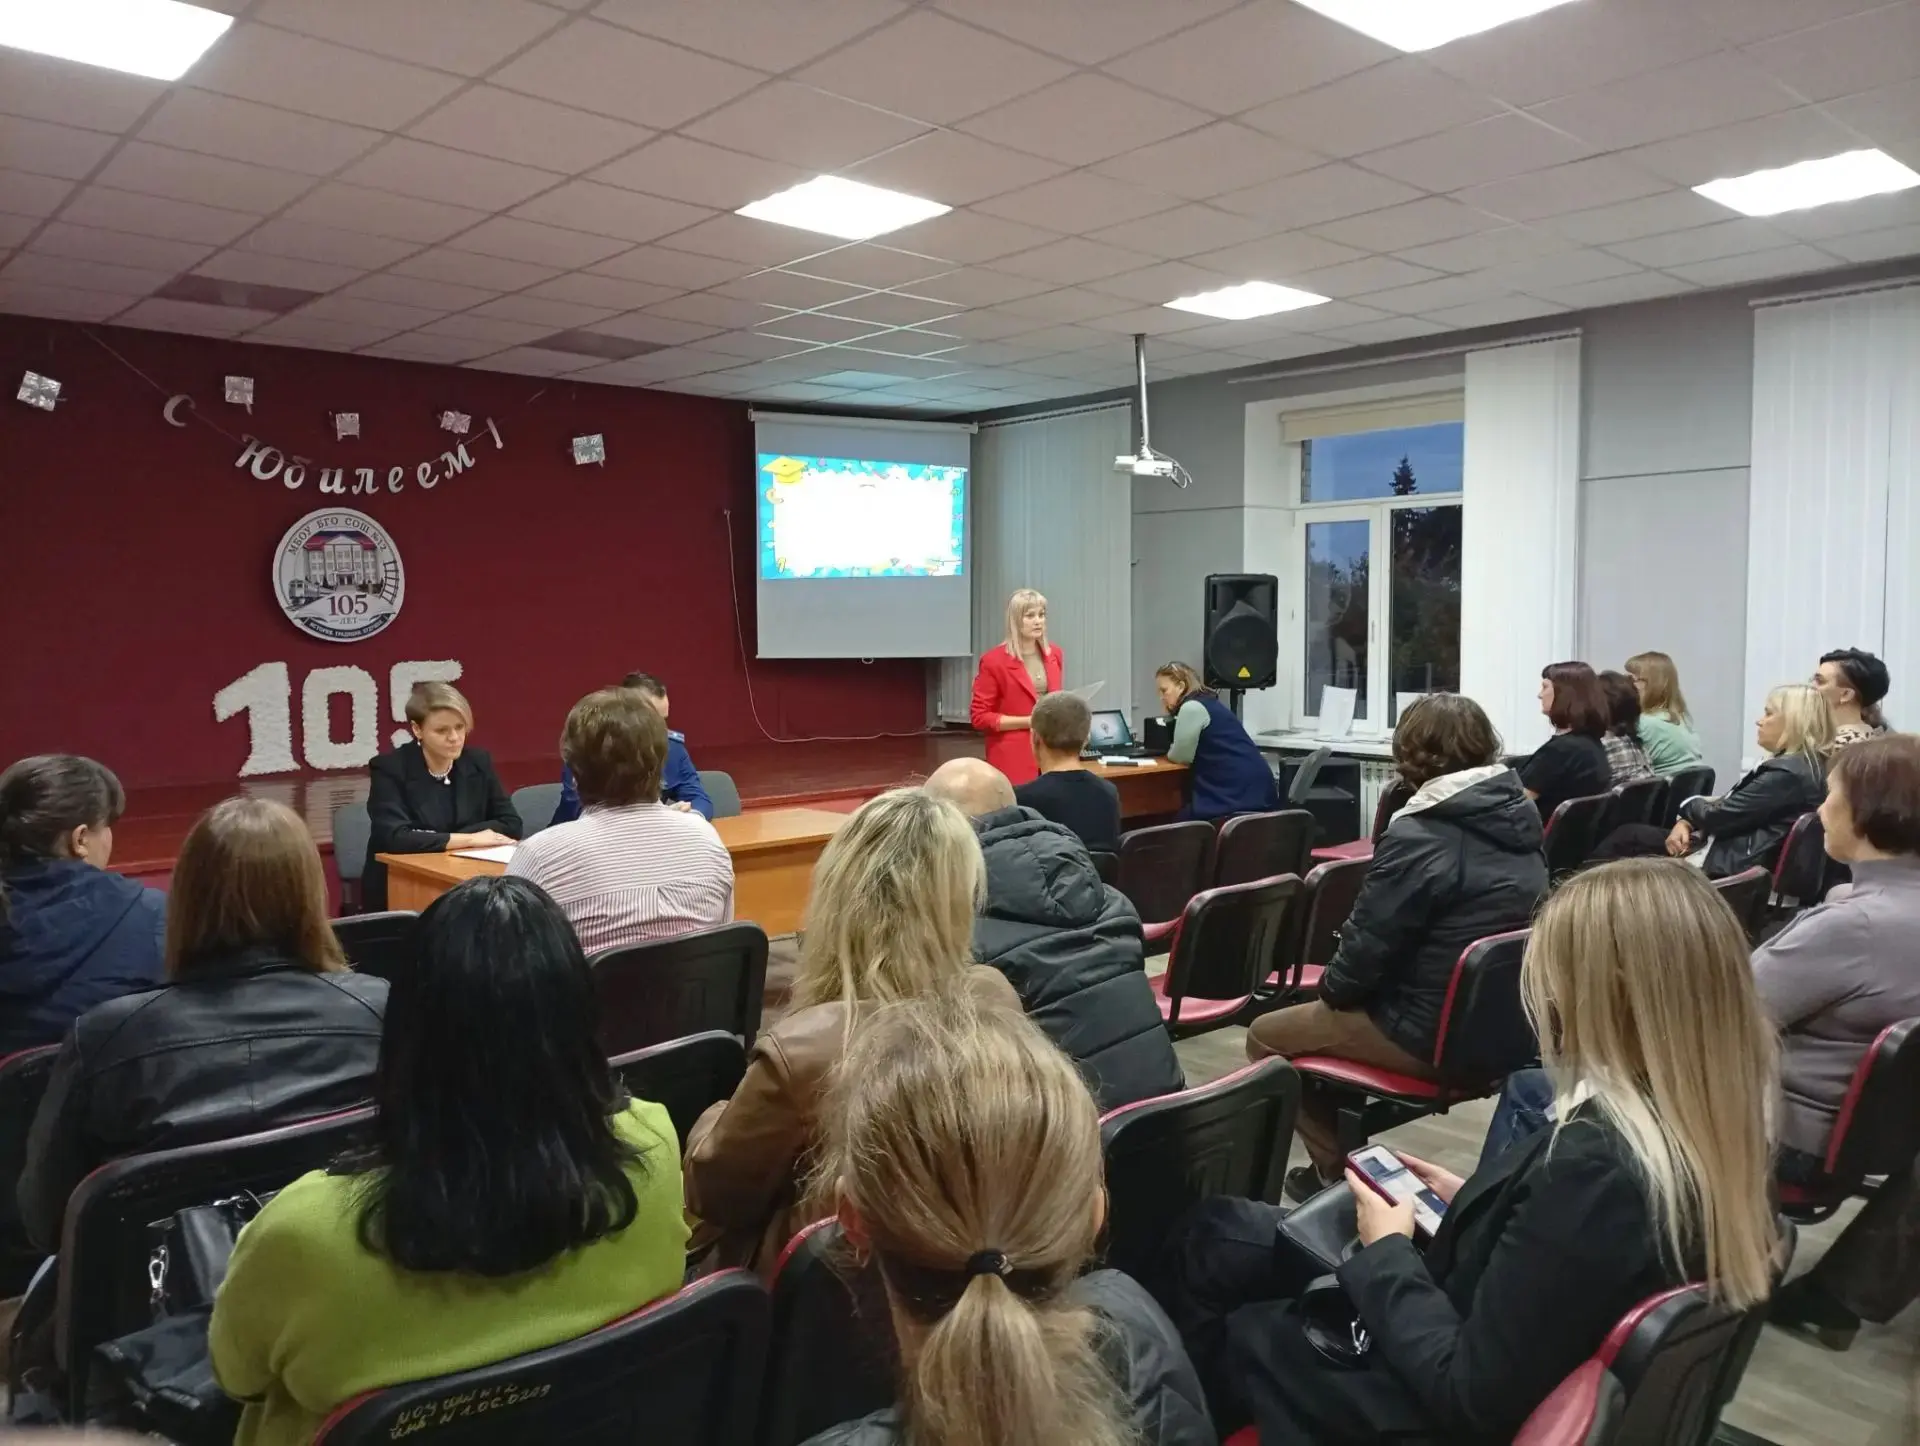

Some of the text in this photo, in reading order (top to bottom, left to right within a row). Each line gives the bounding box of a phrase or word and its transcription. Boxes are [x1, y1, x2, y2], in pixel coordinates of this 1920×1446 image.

[288, 516, 387, 556] МБОУ БГО СОШ №12
[328, 594, 369, 616] 105
[339, 617, 358, 625] ЛЕТ
